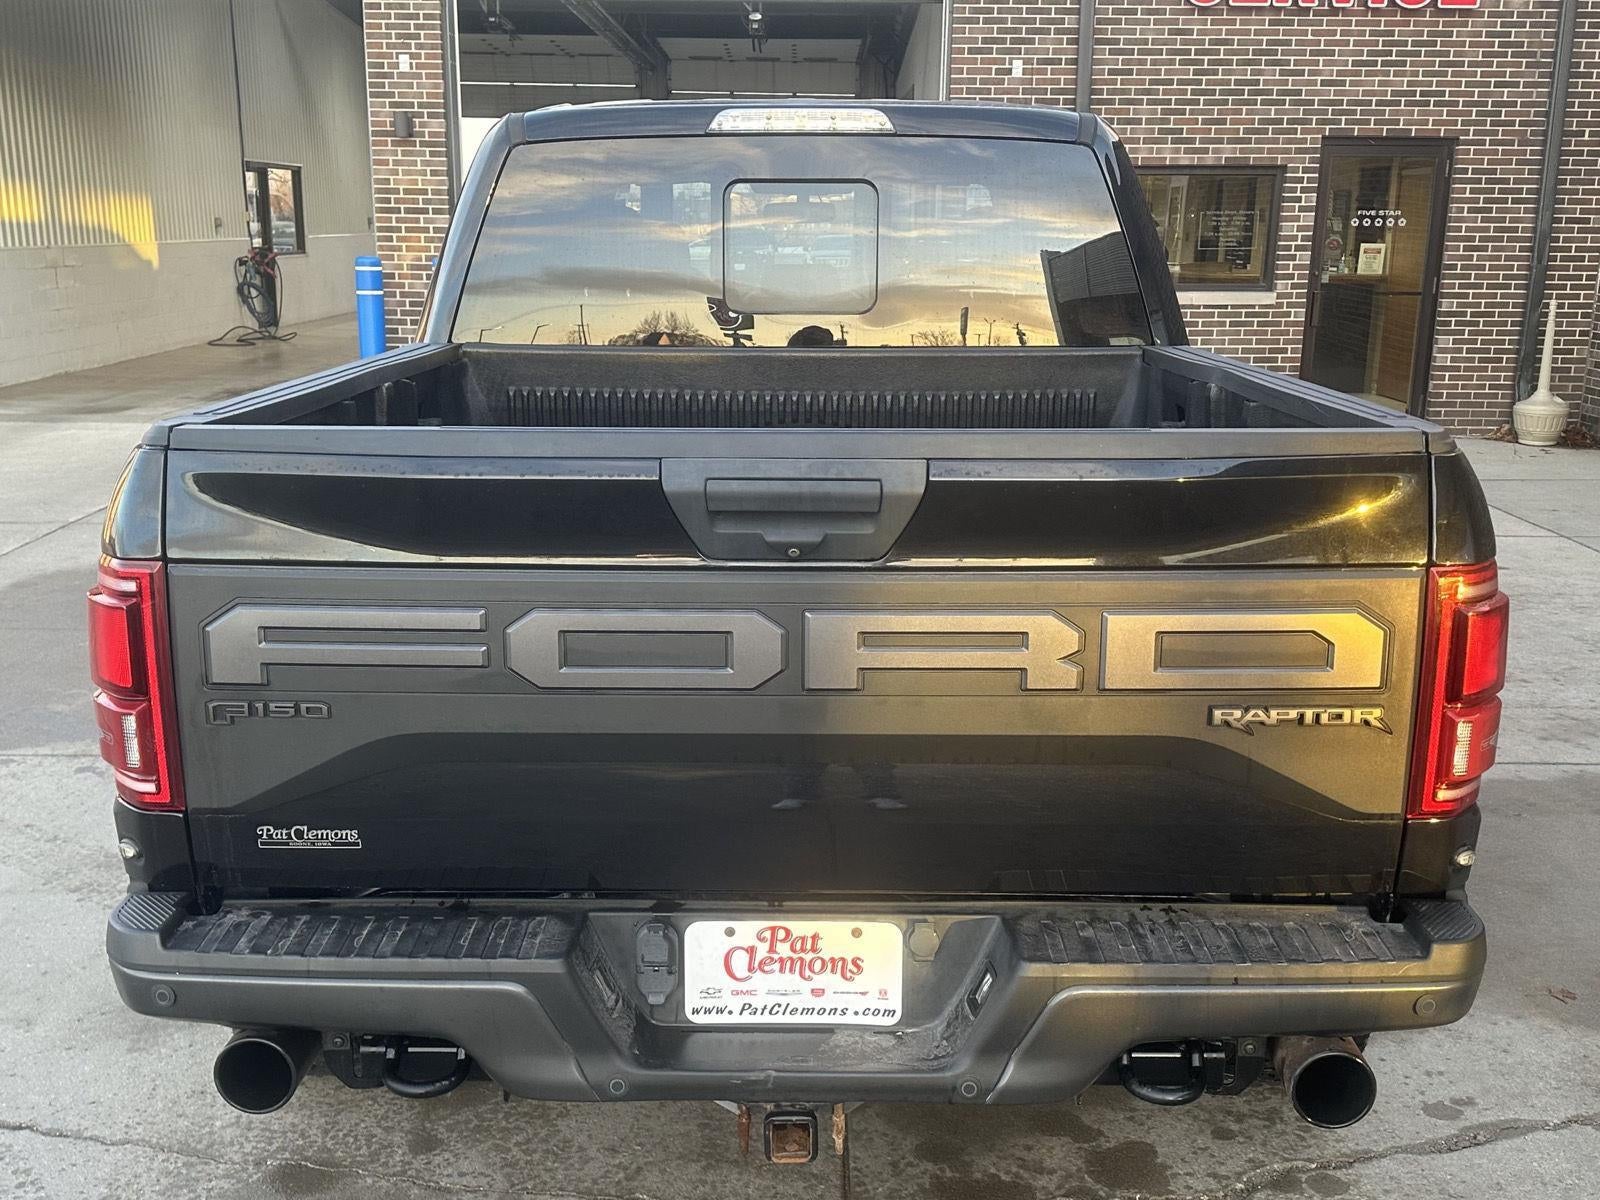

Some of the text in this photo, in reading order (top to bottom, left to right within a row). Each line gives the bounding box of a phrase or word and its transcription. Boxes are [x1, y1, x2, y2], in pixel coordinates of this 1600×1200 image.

[204, 603, 1387, 691] FORD
[1209, 705, 1393, 736] RAPTOR
[257, 825, 359, 843] Pat Clemons
[756, 925, 823, 955] Pat
[723, 945, 865, 983] Clemons
[730, 989, 758, 997] GMC
